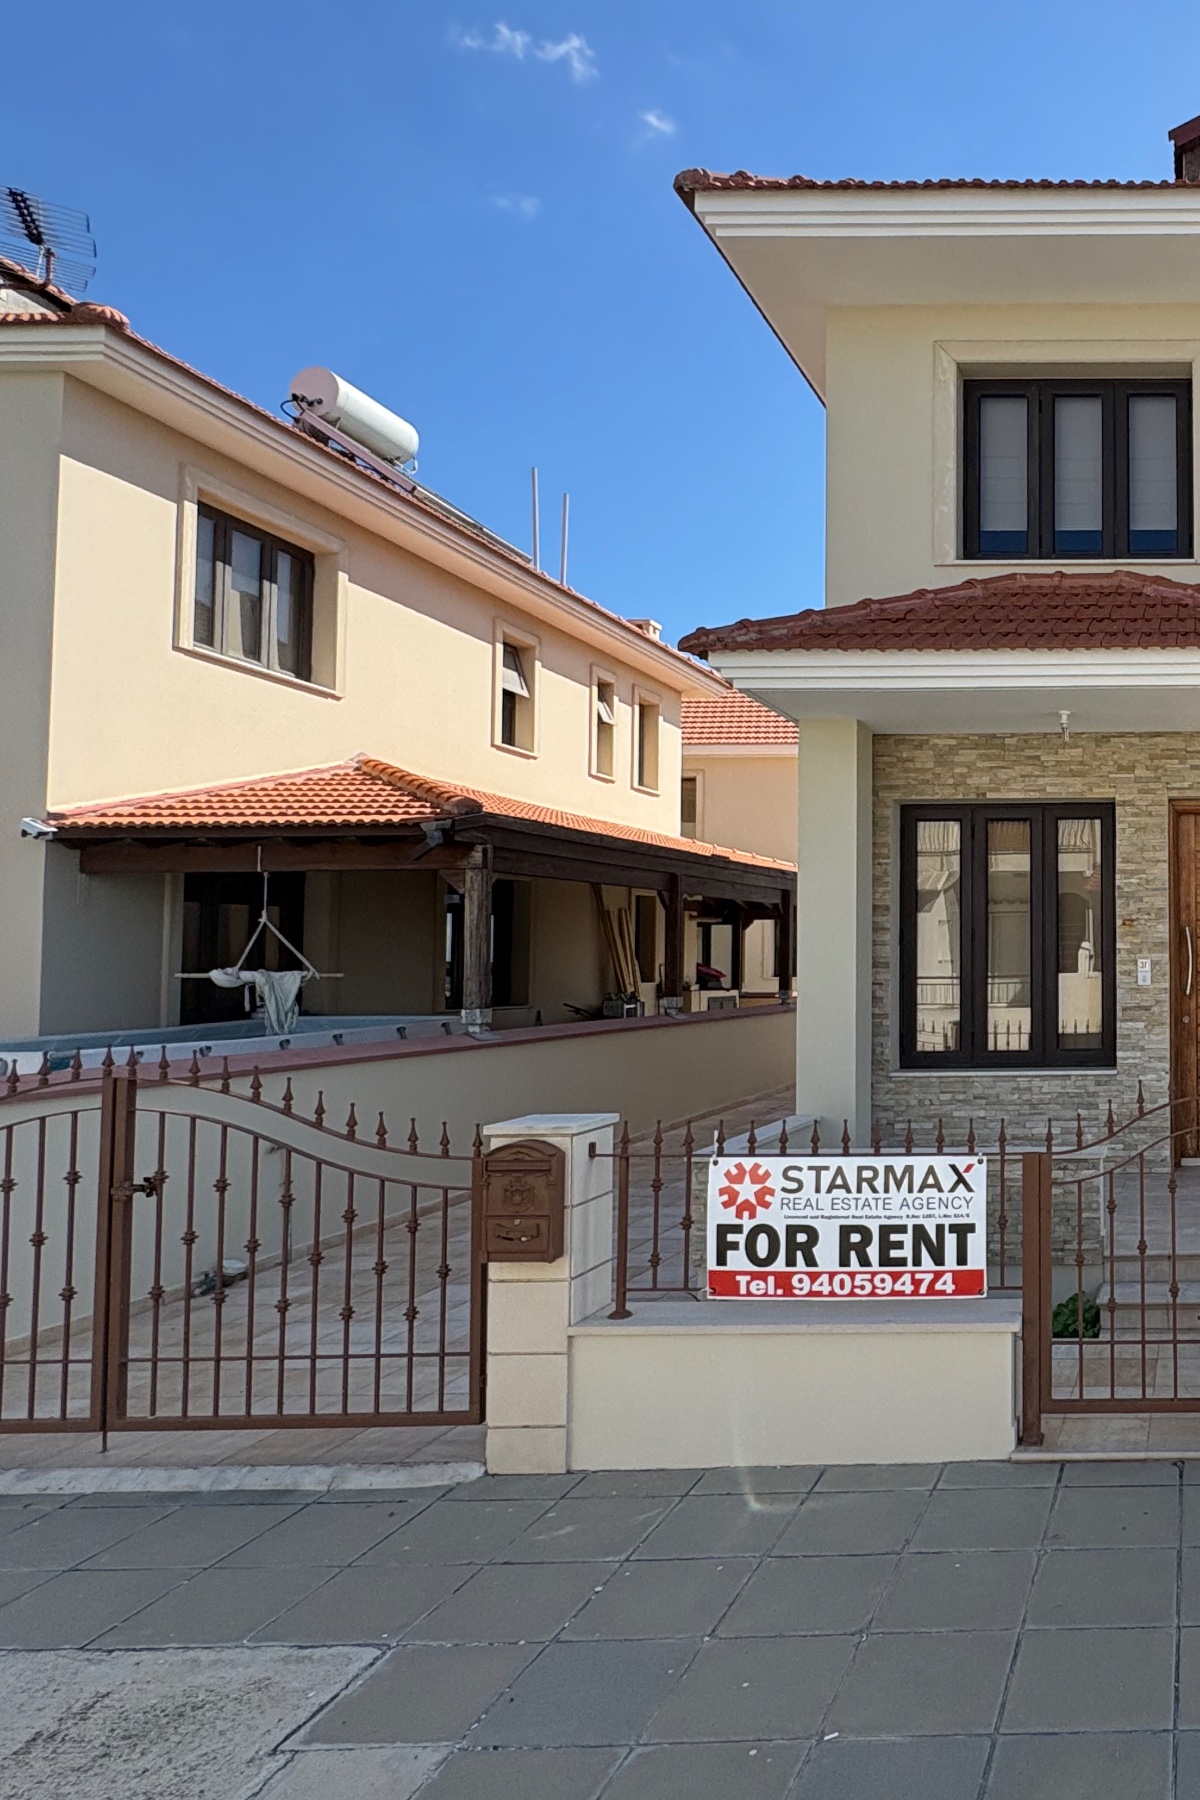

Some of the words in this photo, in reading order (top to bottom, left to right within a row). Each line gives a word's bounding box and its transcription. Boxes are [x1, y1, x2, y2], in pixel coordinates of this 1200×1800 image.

[780, 1163, 976, 1195] STARMAX
[780, 1197, 825, 1211] REAL
[831, 1197, 893, 1211] ESTATE
[899, 1196, 974, 1211] AGENCY
[716, 1223, 820, 1268] FOR
[839, 1222, 976, 1268] RENT
[736, 1275, 783, 1295] Tel.
[791, 1272, 955, 1295] 94059474
